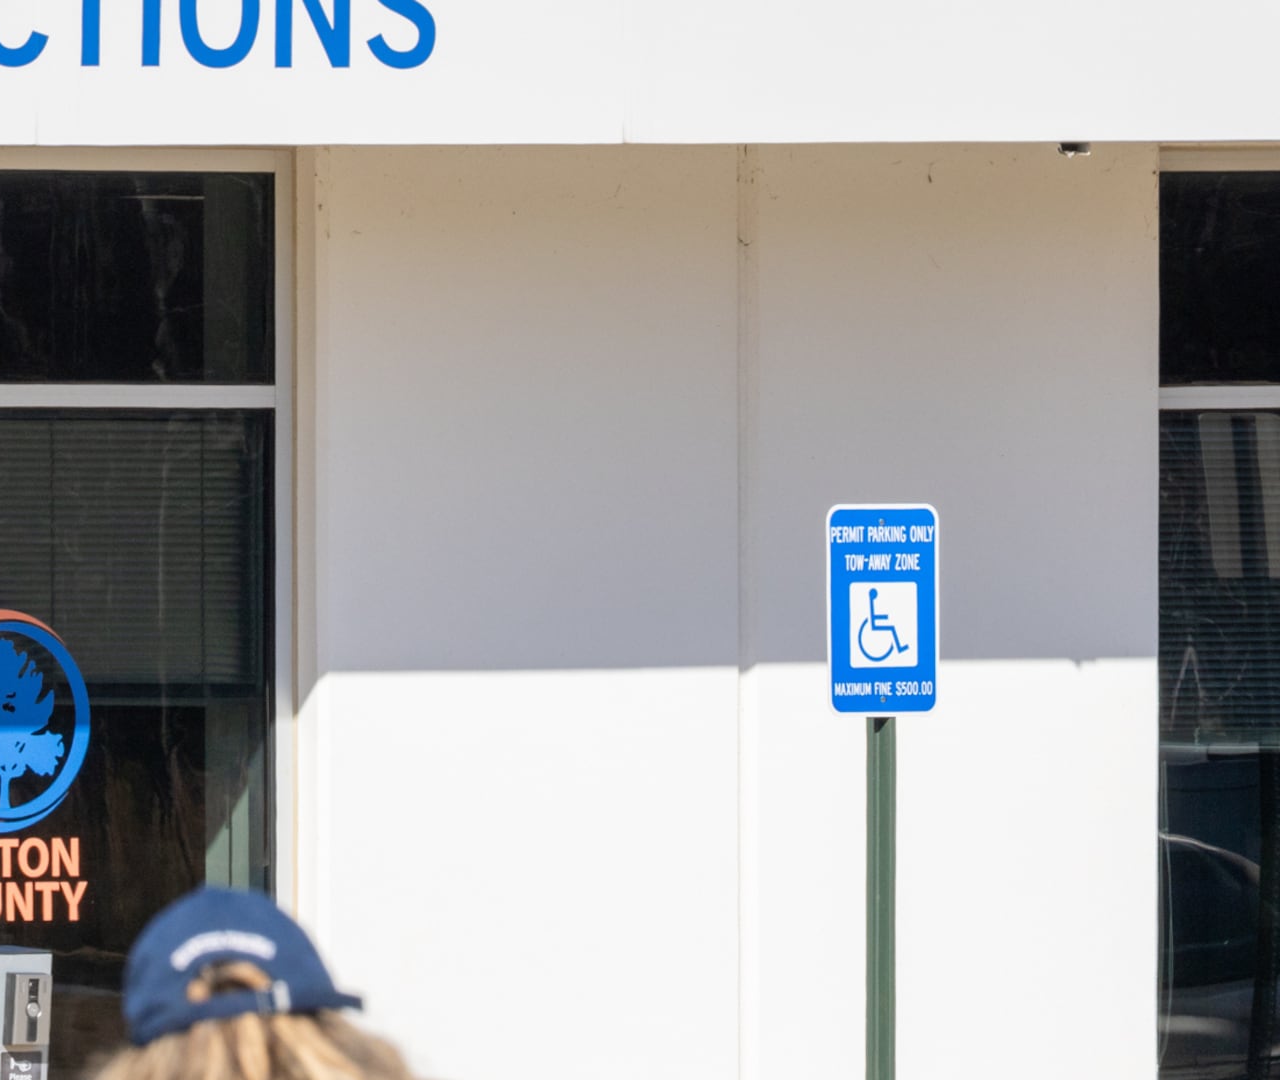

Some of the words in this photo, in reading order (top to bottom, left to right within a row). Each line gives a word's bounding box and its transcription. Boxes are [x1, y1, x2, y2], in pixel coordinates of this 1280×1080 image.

[831, 526, 865, 544] PERMIT
[868, 526, 907, 543] PARKING
[910, 525, 934, 543] ONLY
[845, 554, 892, 571] TOW-AWAY
[895, 553, 920, 571] ZONE
[835, 682, 873, 696] MAXIMUM
[875, 681, 892, 695] FINE
[896, 681, 933, 696] $500.00
